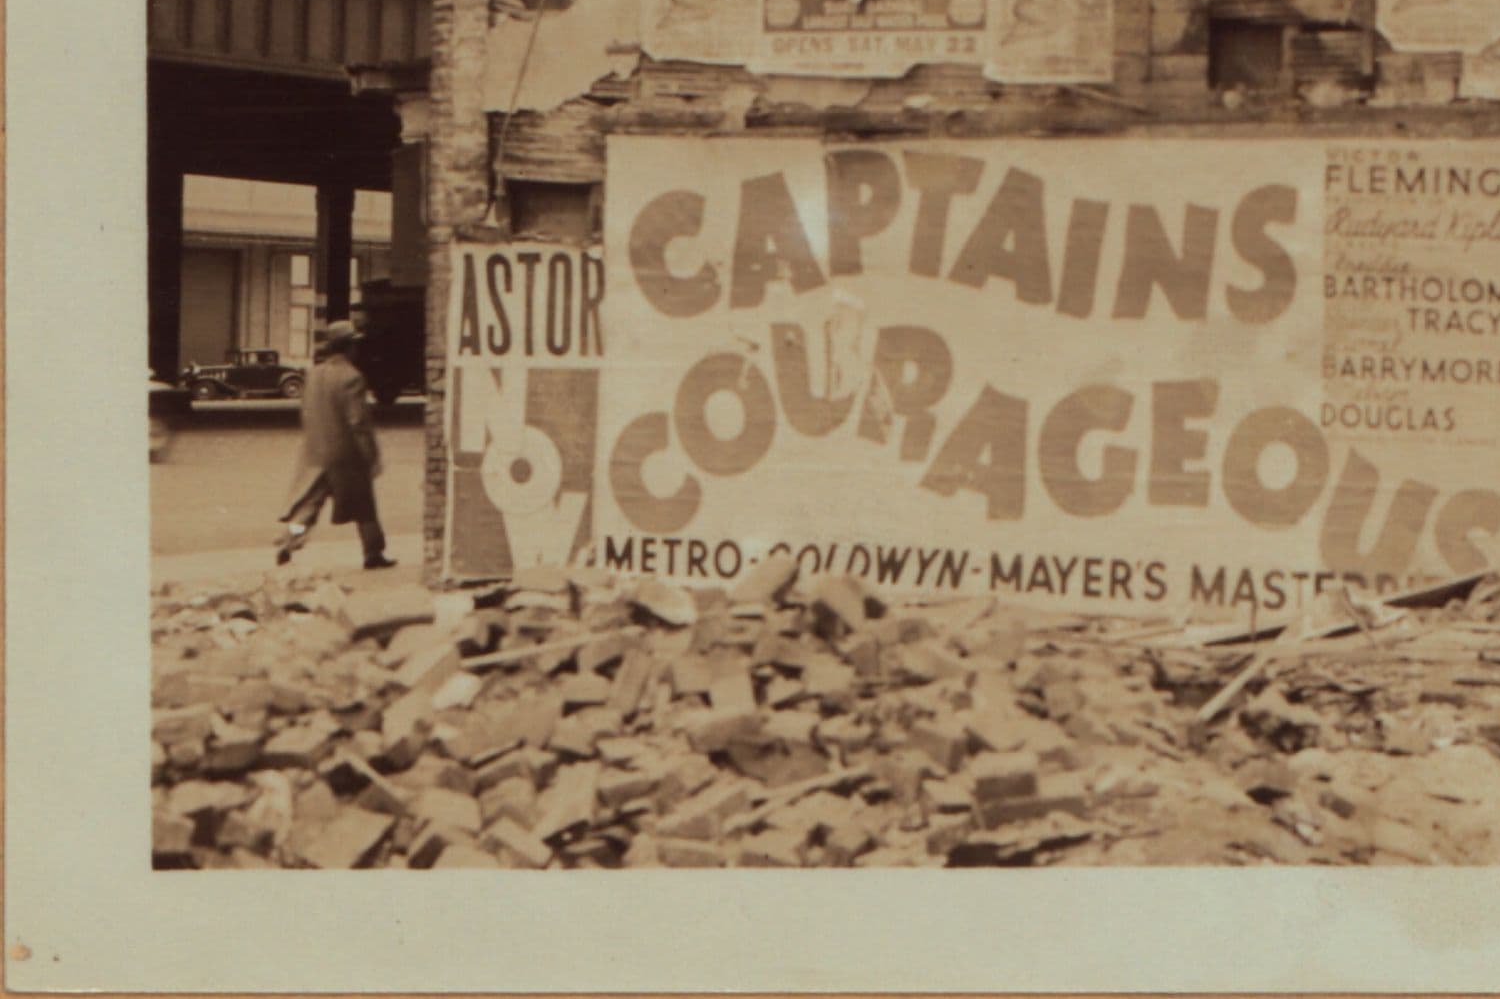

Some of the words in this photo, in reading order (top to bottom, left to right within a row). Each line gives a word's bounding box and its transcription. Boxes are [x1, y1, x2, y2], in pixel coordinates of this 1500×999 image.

[628, 148, 1298, 325] CAPTAINS
[457, 250, 606, 358] ASTOR
[1320, 402, 1457, 432] DOUGLAS
